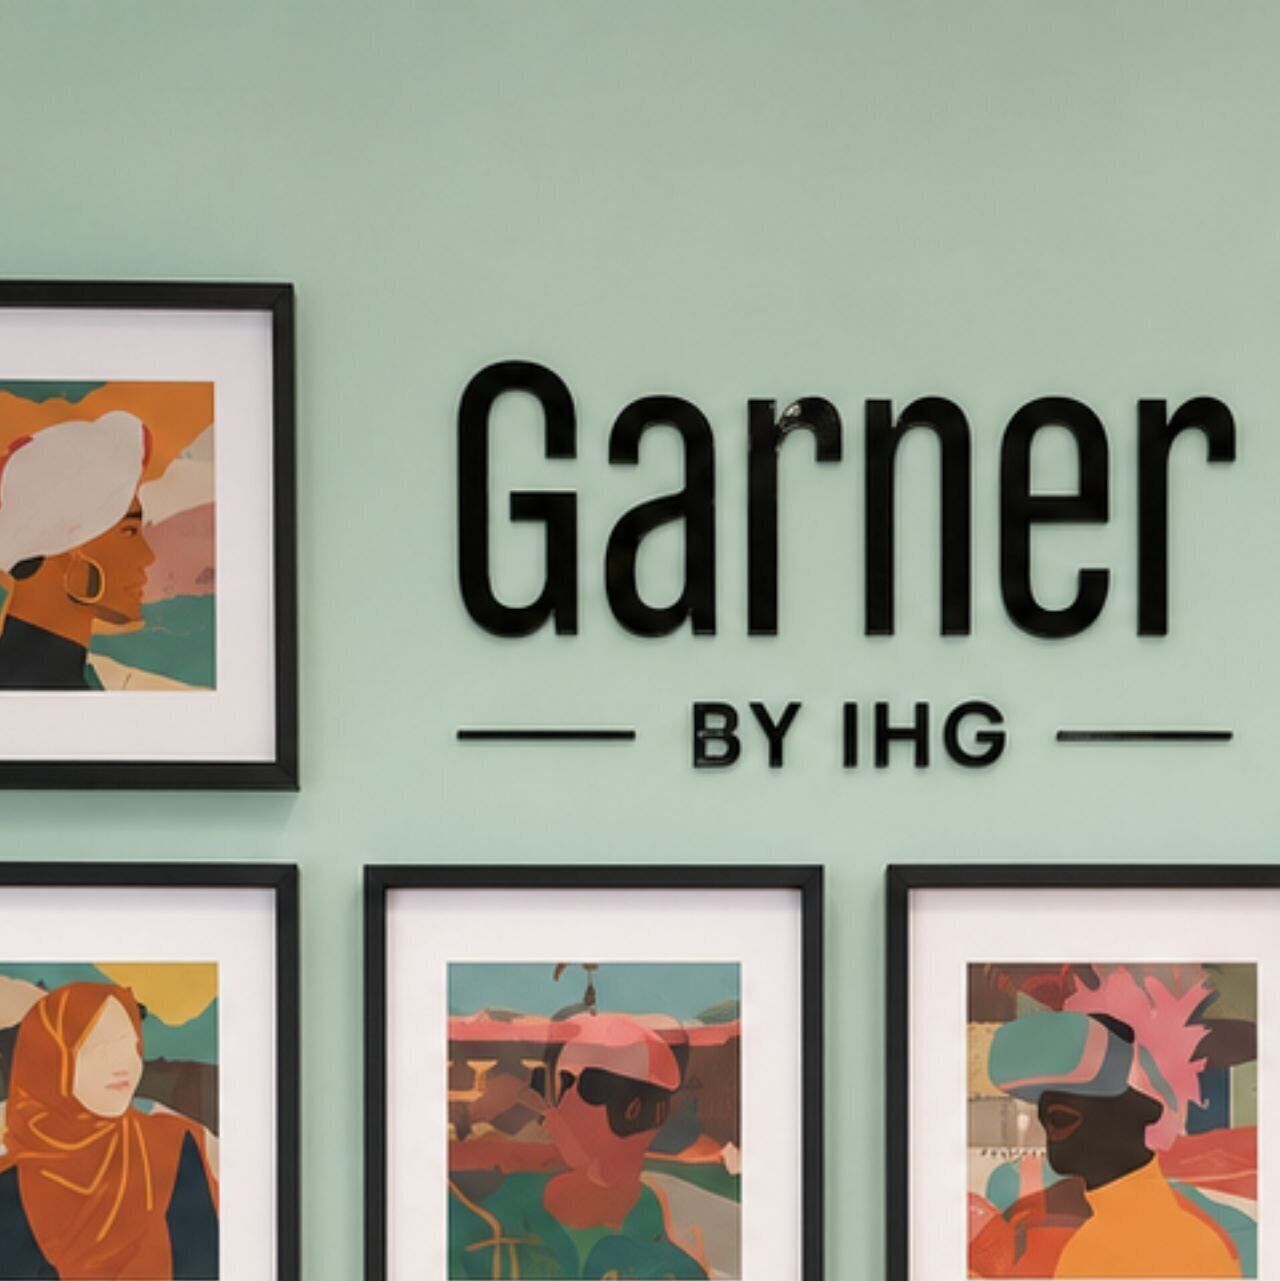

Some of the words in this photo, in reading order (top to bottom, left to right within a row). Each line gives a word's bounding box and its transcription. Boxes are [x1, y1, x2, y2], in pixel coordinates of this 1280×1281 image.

[457, 360, 1236, 640] Garner
[692, 701, 803, 769] BY
[842, 700, 1008, 769] IHG
